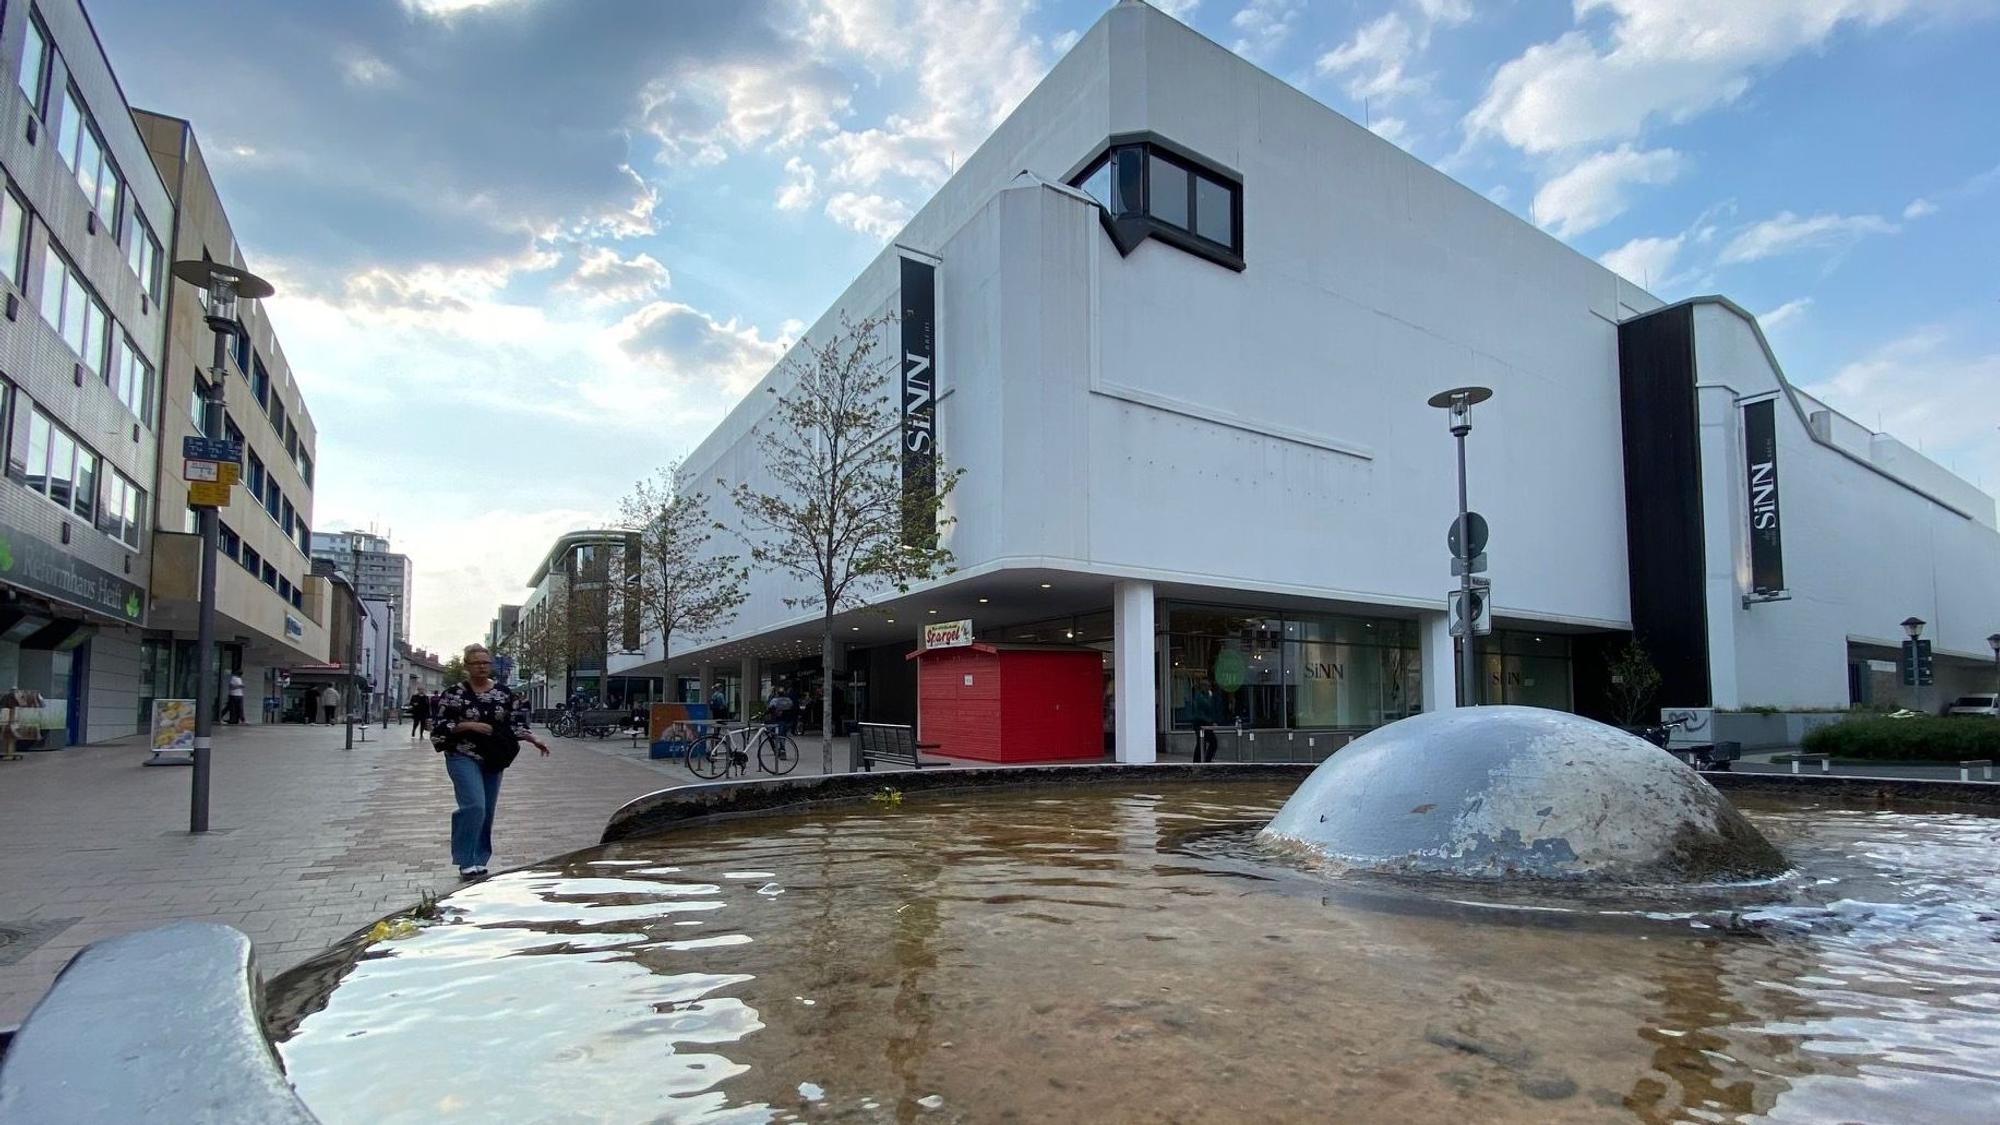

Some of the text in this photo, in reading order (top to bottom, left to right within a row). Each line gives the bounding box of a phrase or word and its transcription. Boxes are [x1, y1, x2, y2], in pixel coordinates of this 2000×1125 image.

[1752, 461, 1776, 529] SiNN
[927, 628, 960, 646] Spargel
[1304, 663, 1344, 679] SiNN
